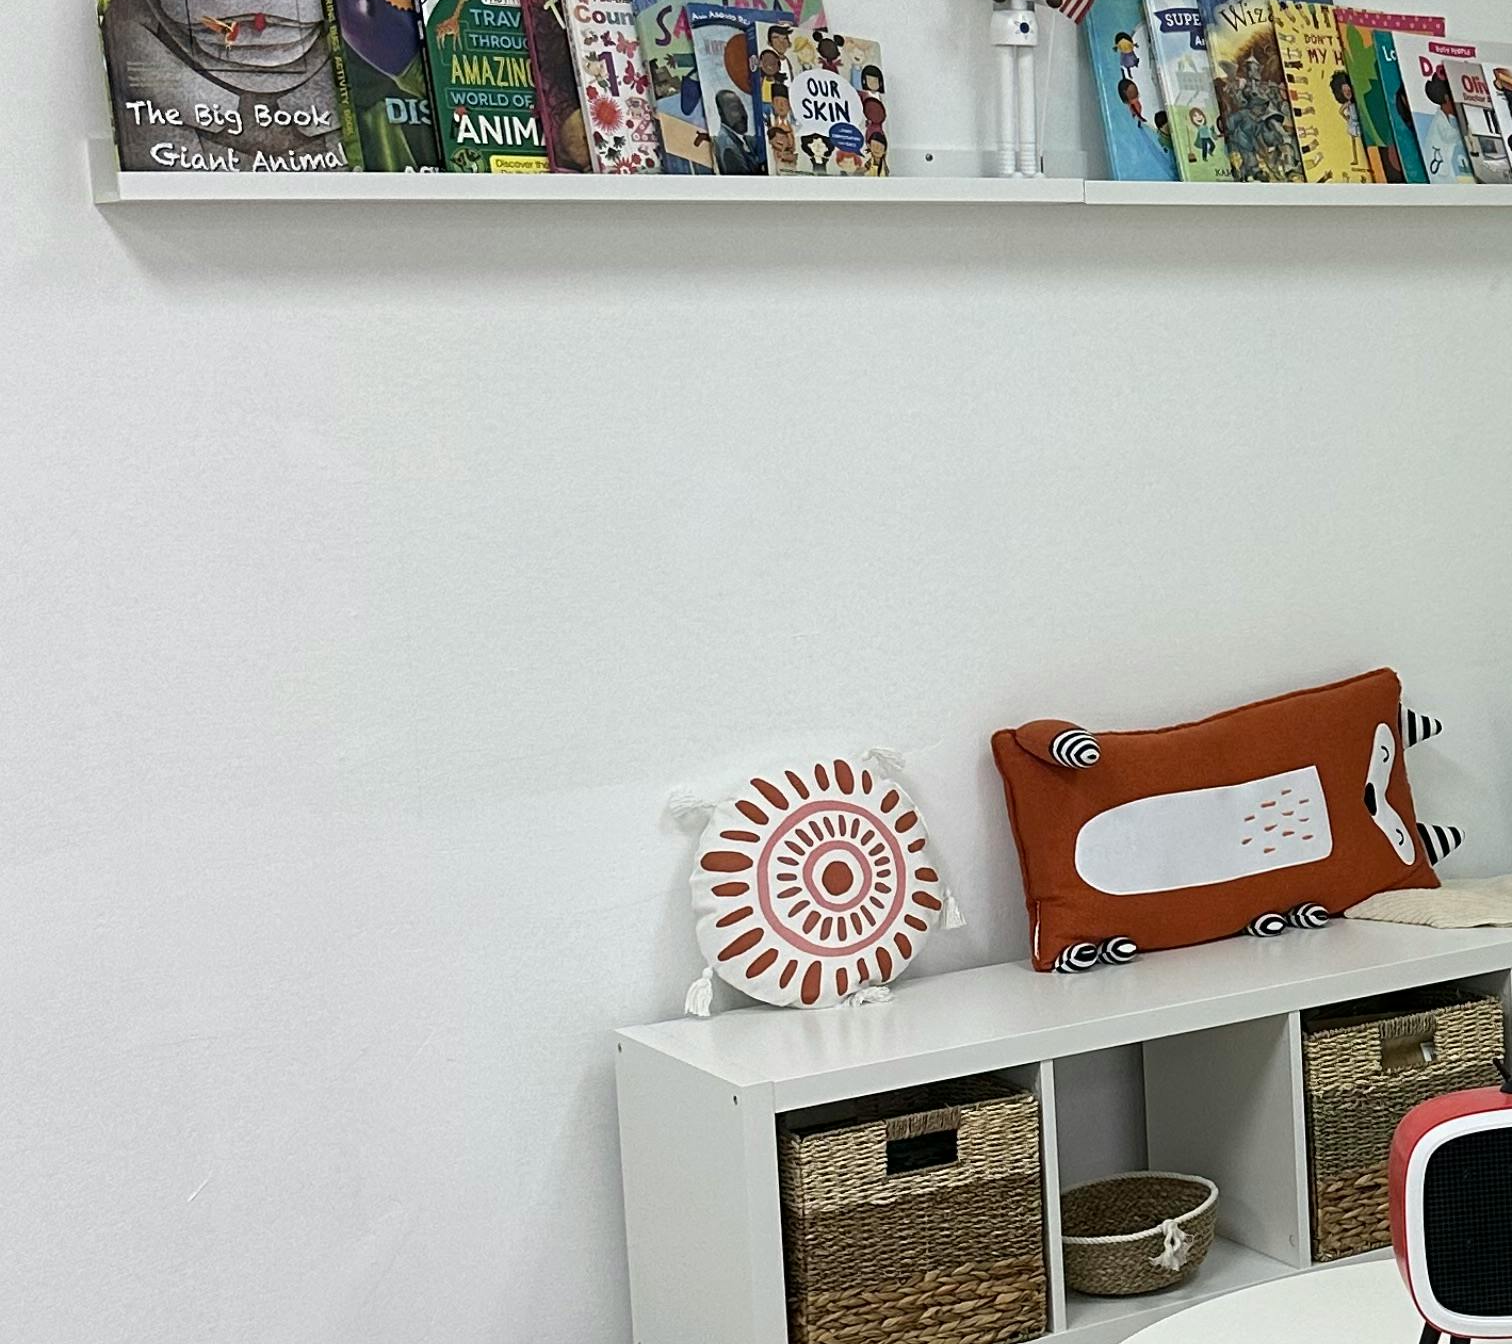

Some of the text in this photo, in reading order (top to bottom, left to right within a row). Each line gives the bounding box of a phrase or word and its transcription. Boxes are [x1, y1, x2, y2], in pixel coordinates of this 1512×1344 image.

[1307, 48, 1328, 64] MY
[450, 91, 534, 109] WORLD OF
[806, 77, 842, 99] OUR
[125, 99, 331, 136] The Big Book
[801, 97, 852, 123] SKIN
[456, 114, 546, 146] ANIM
[149, 142, 241, 172] Giant
